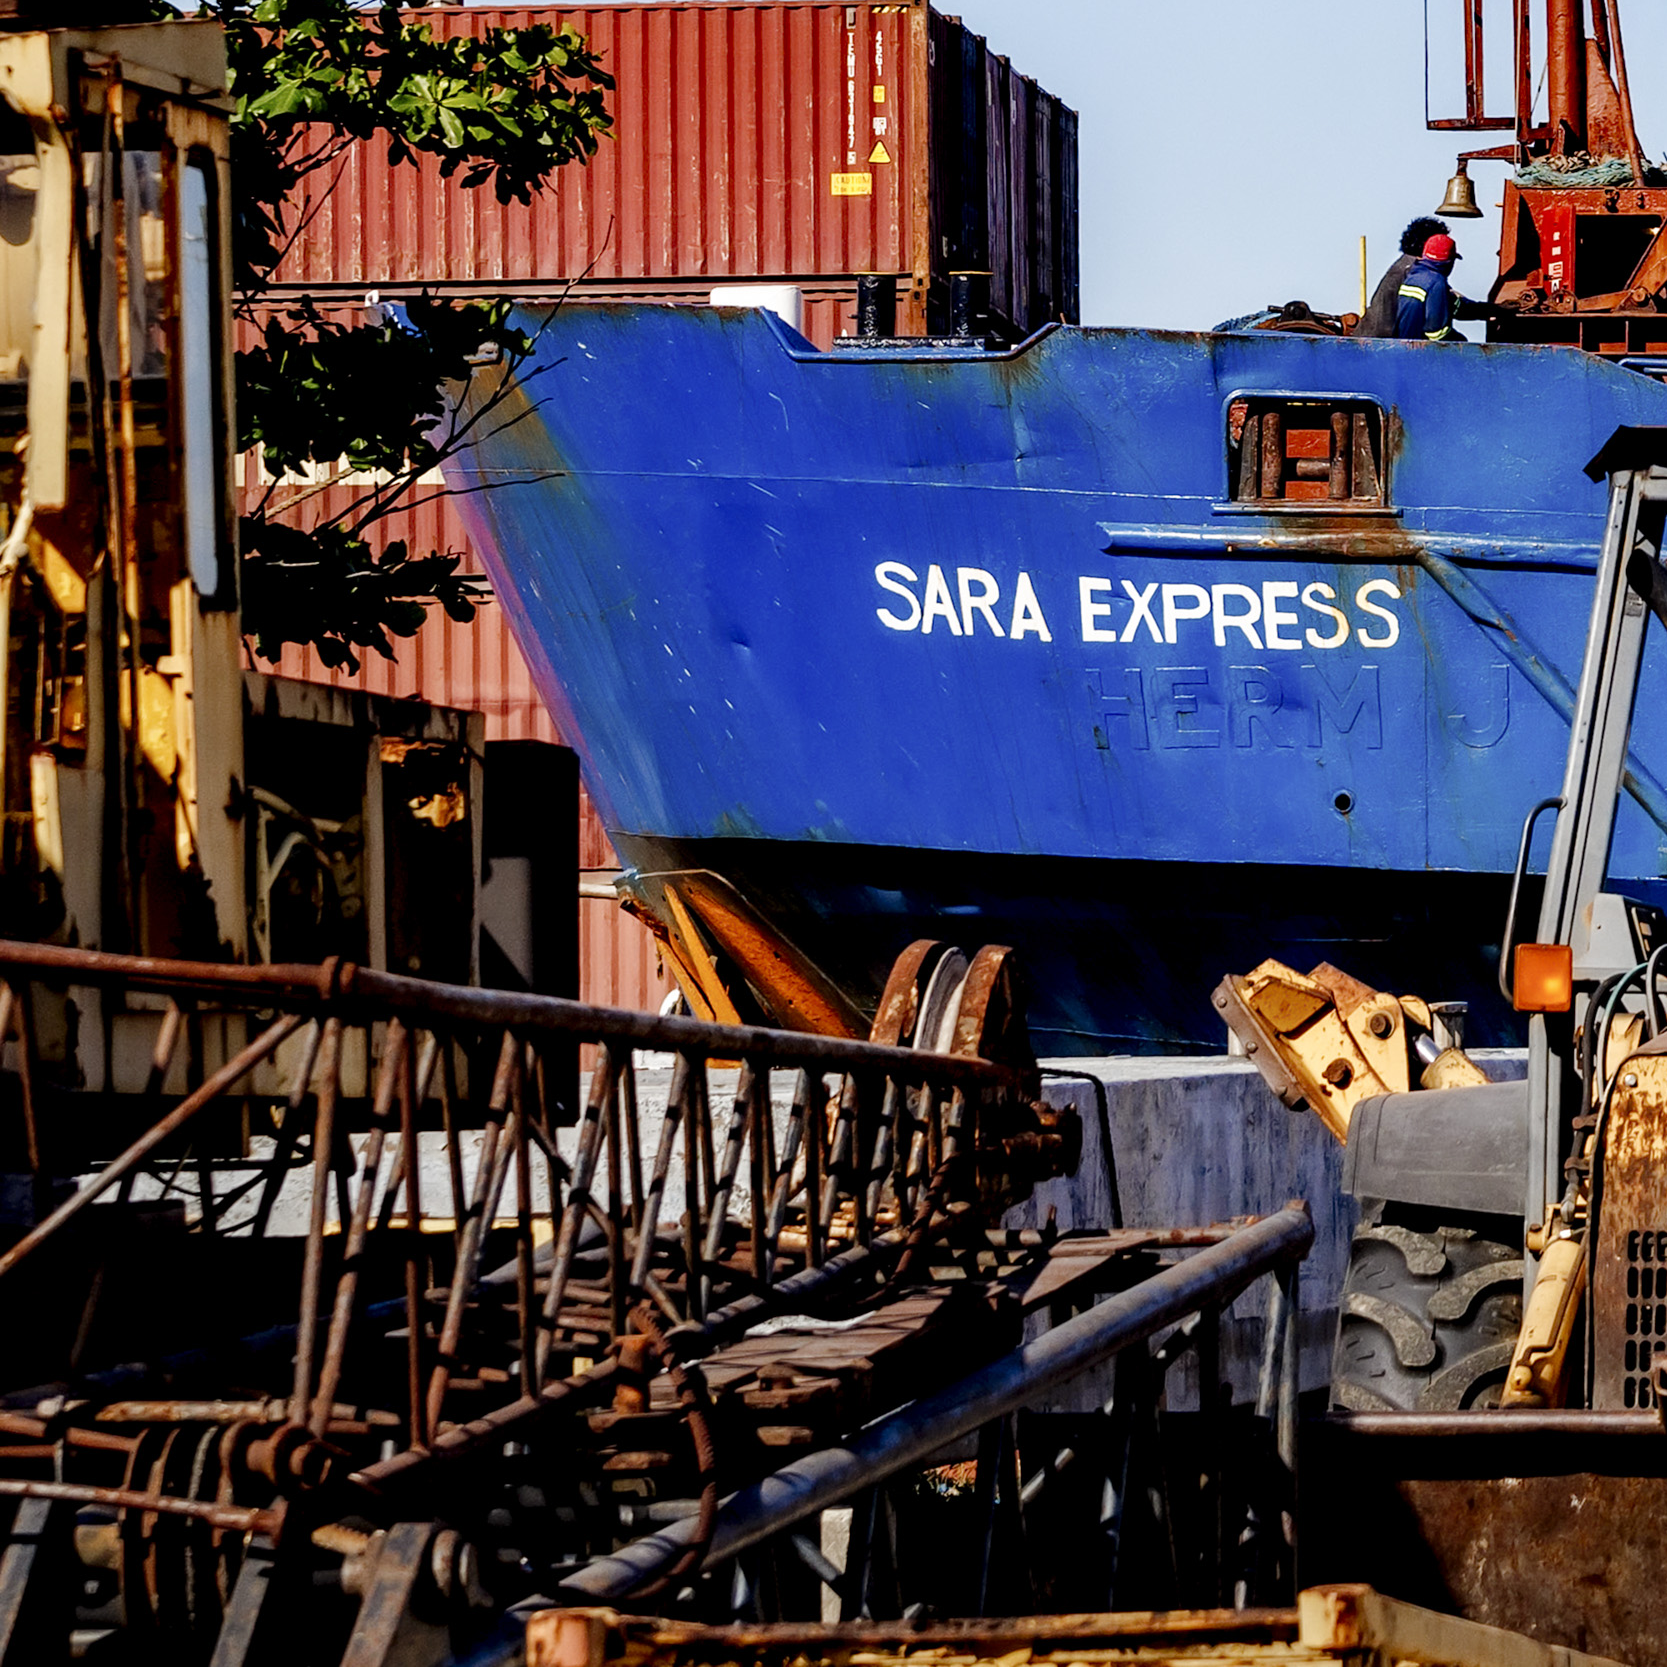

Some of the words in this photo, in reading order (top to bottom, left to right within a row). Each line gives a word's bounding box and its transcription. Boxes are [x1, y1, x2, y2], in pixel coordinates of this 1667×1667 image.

[875, 561, 1053, 643] SARA
[1079, 576, 1402, 651] EXPRESS
[1085, 664, 1384, 751] HERM
